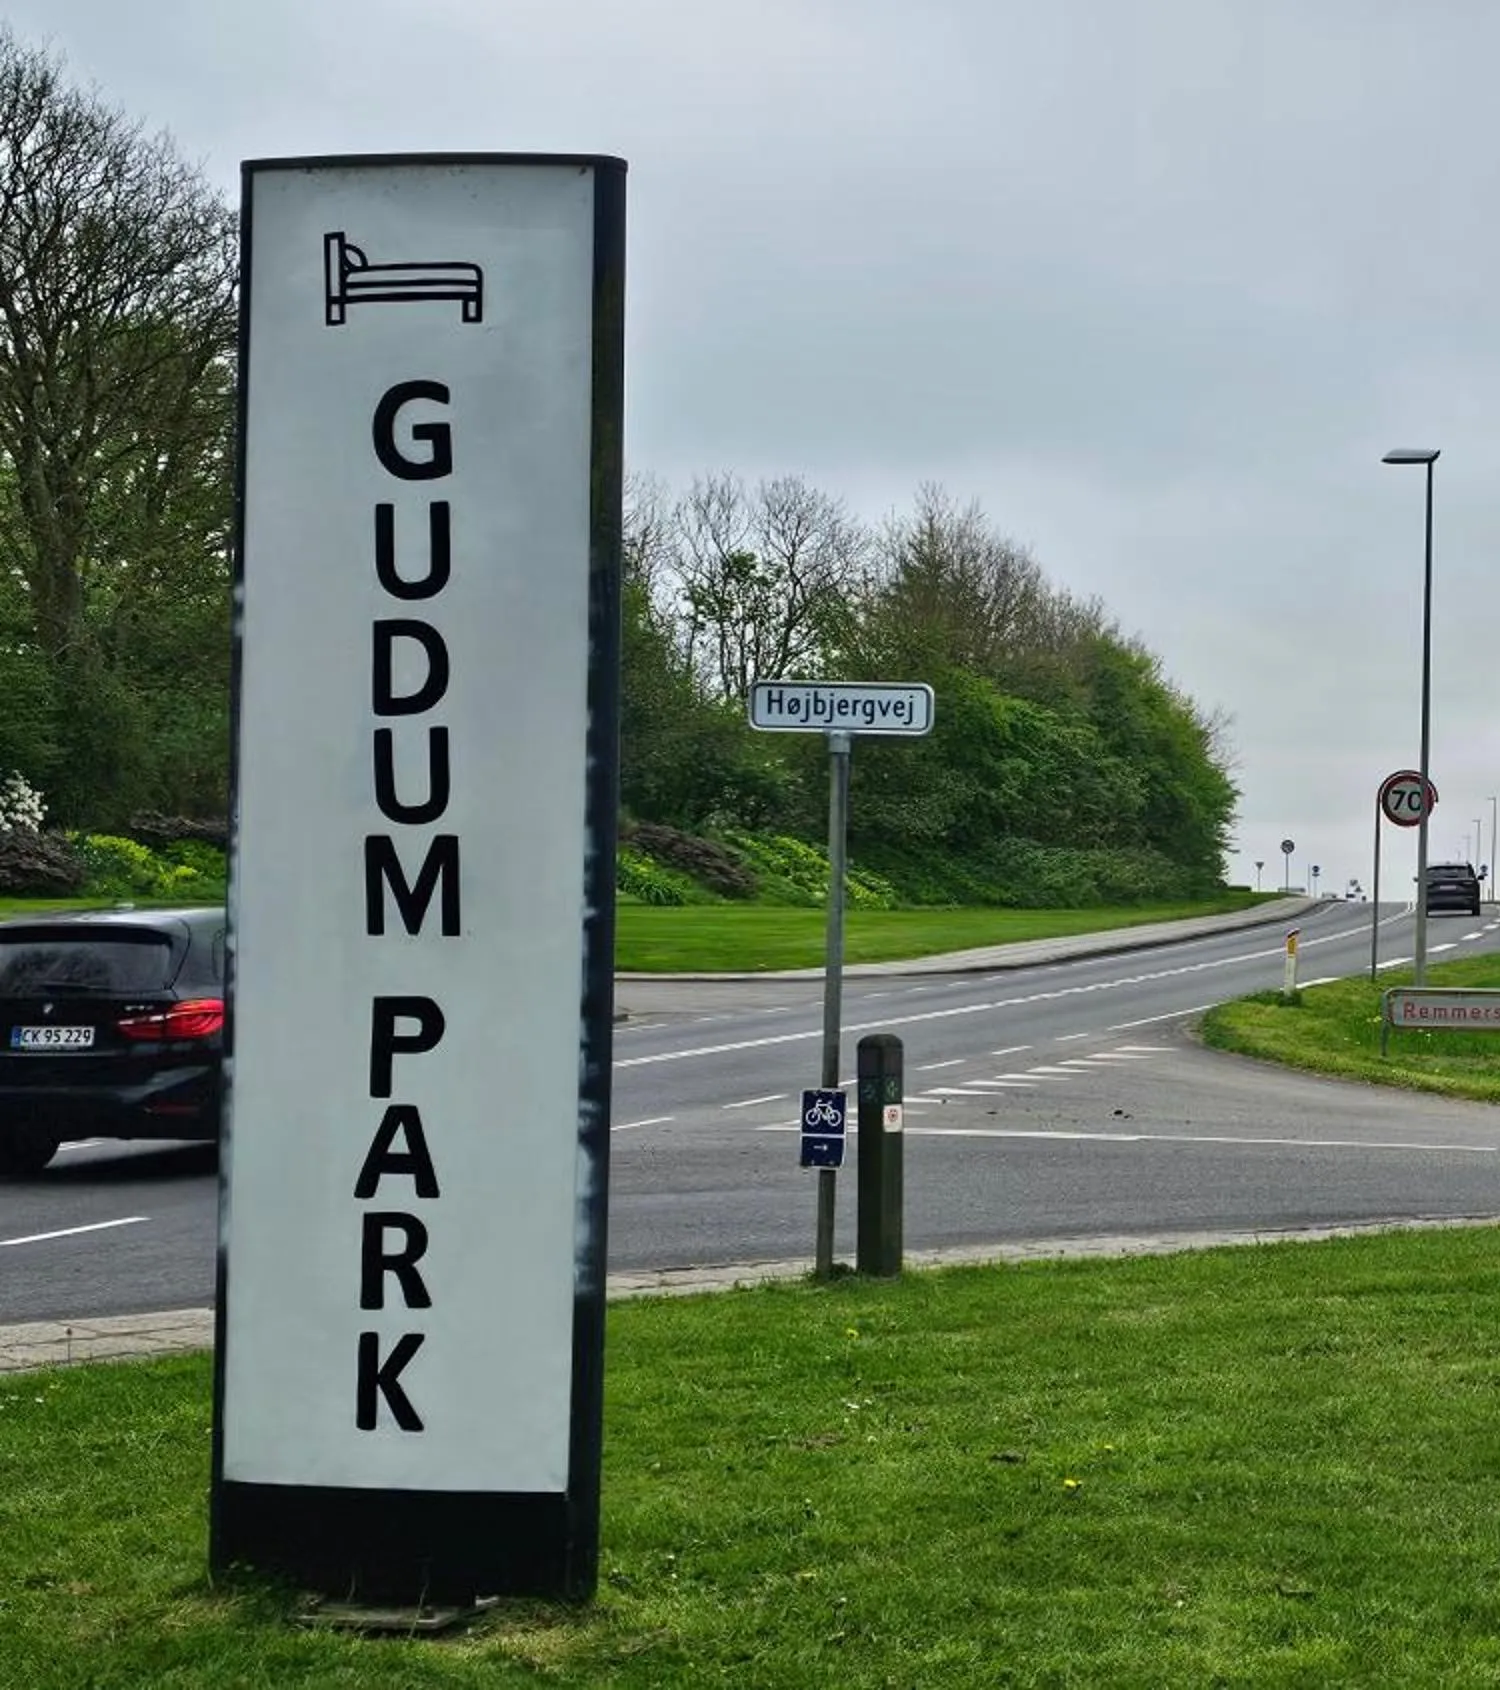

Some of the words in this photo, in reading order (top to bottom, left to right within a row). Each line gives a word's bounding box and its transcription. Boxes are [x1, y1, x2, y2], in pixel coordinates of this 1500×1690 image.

[362, 380, 462, 937] GUDUM
[767, 689, 914, 725] Højbjergvej
[1391, 789, 1423, 811] 70
[23, 1029, 40, 1043] CK
[45, 1029, 61, 1043] 95
[65, 1029, 91, 1043] 229
[354, 995, 446, 1432] PARK
